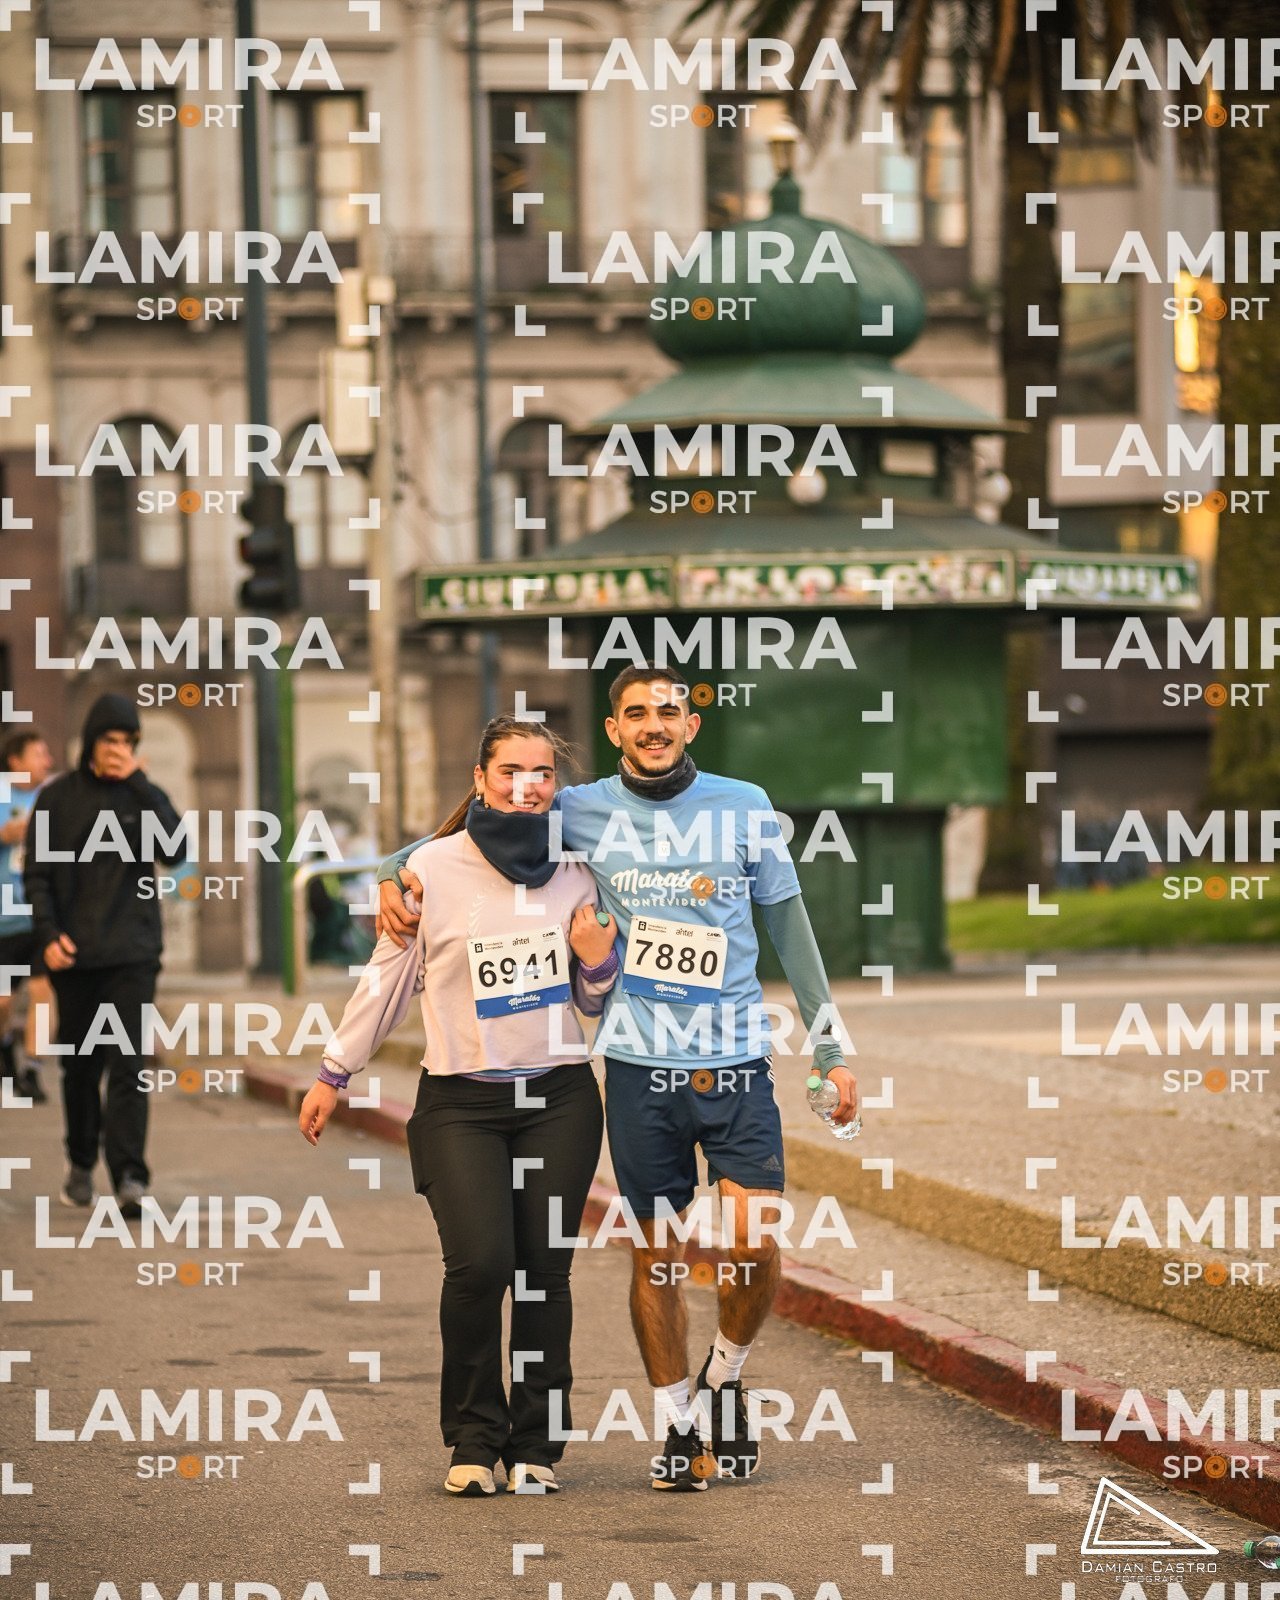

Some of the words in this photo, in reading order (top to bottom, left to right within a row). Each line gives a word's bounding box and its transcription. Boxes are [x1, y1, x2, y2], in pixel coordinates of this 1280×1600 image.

[621, 897, 708, 908] MONTEVIDEO
[478, 949, 558, 988] 6941
[635, 938, 718, 977] 7880
